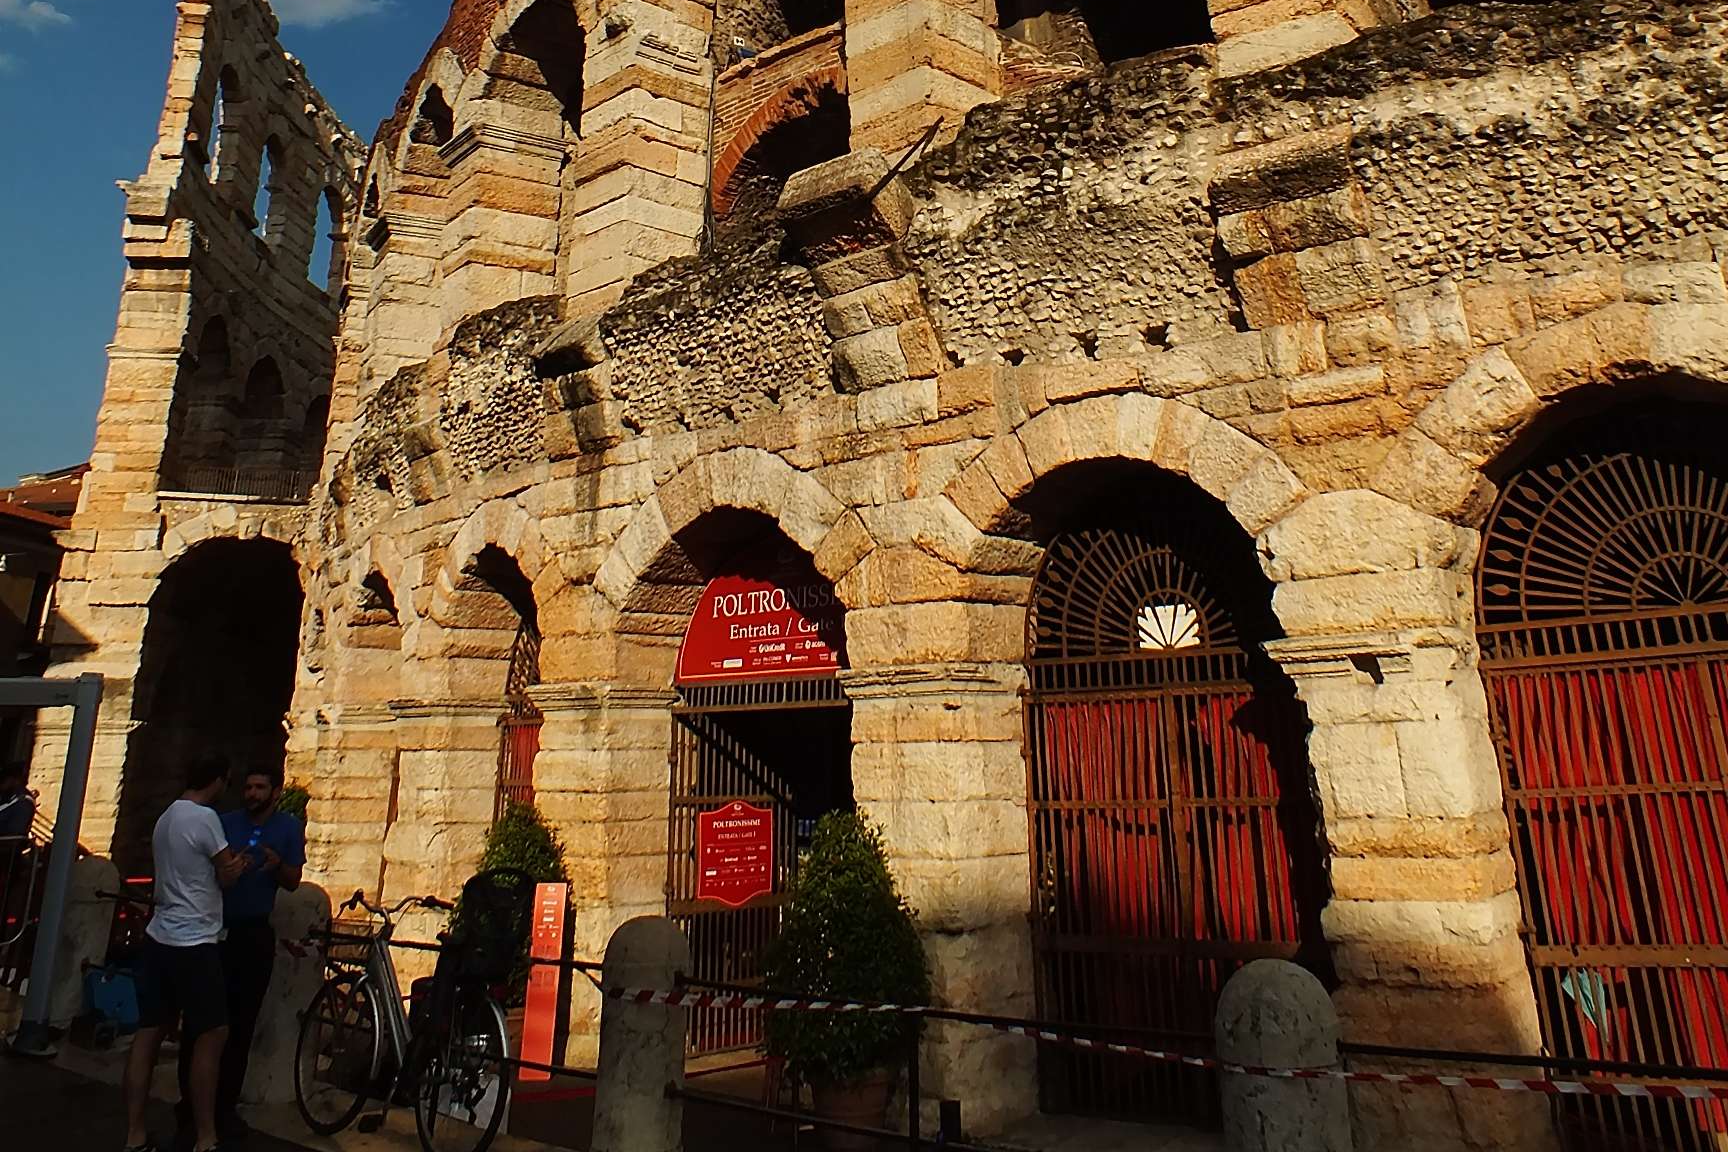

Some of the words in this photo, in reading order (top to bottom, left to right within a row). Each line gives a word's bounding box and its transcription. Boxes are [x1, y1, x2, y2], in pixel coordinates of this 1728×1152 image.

[729, 622, 780, 639] Entrata
[785, 617, 793, 636] /
[798, 617, 834, 633] Gate
